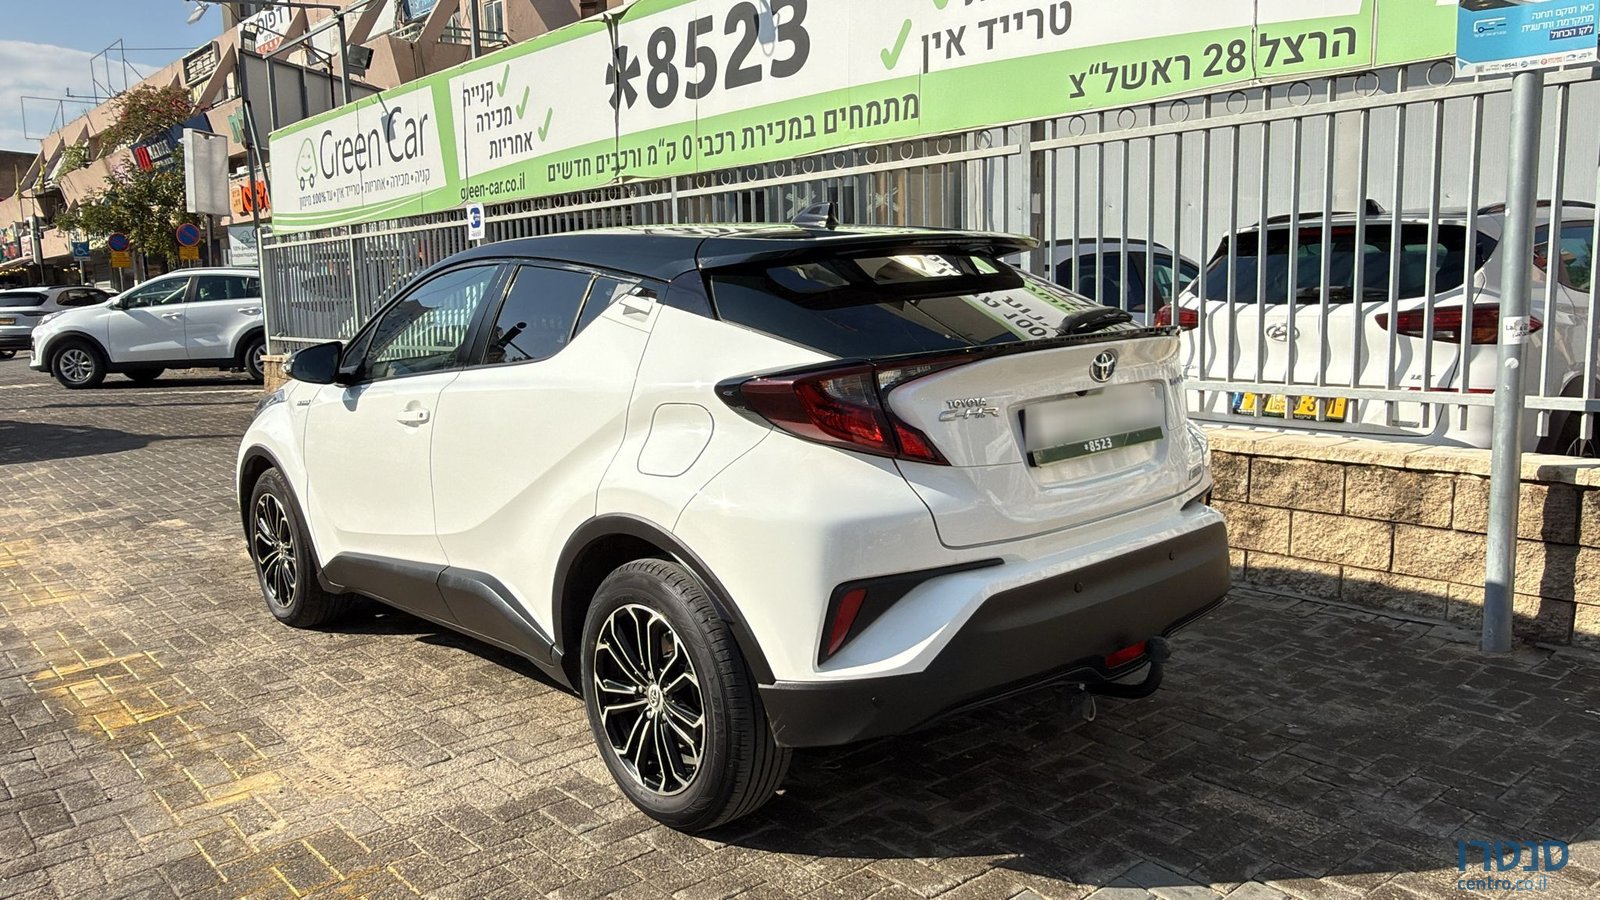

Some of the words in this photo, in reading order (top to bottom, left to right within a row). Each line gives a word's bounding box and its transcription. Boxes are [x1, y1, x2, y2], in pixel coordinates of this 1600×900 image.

[1531, 10, 1553, 20] תחנה
[1556, 15, 1594, 27] מתקדמת
[1580, 3, 1595, 14] כאן
[978, 1, 1072, 50] טרייד
[1550, 28, 1576, 39] הכחול
[921, 25, 966, 74] אין
[1203, 39, 1246, 77] 28
[1259, 26, 1356, 68] הרצל
[1069, 55, 1191, 99] ראשל"צ
[462, 80, 494, 107] קנייה
[476, 106, 513, 133] מכירה
[824, 93, 919, 135] מתמחים
[319, 130, 381, 180] Green
[387, 106, 428, 162] Car
[489, 131, 534, 159] אחריות
[697, 131, 735, 157] רכבי
[741, 114, 816, 150] במכירת
[682, 135, 693, 160] 0
[548, 157, 592, 182] חדשים
[596, 148, 642, 175] ורכבים
[364, 177, 386, 193] אחריות
[390, 173, 410, 188] מכירה
[415, 168, 430, 185] קניה
[946, 398, 987, 409] TOYOTA
